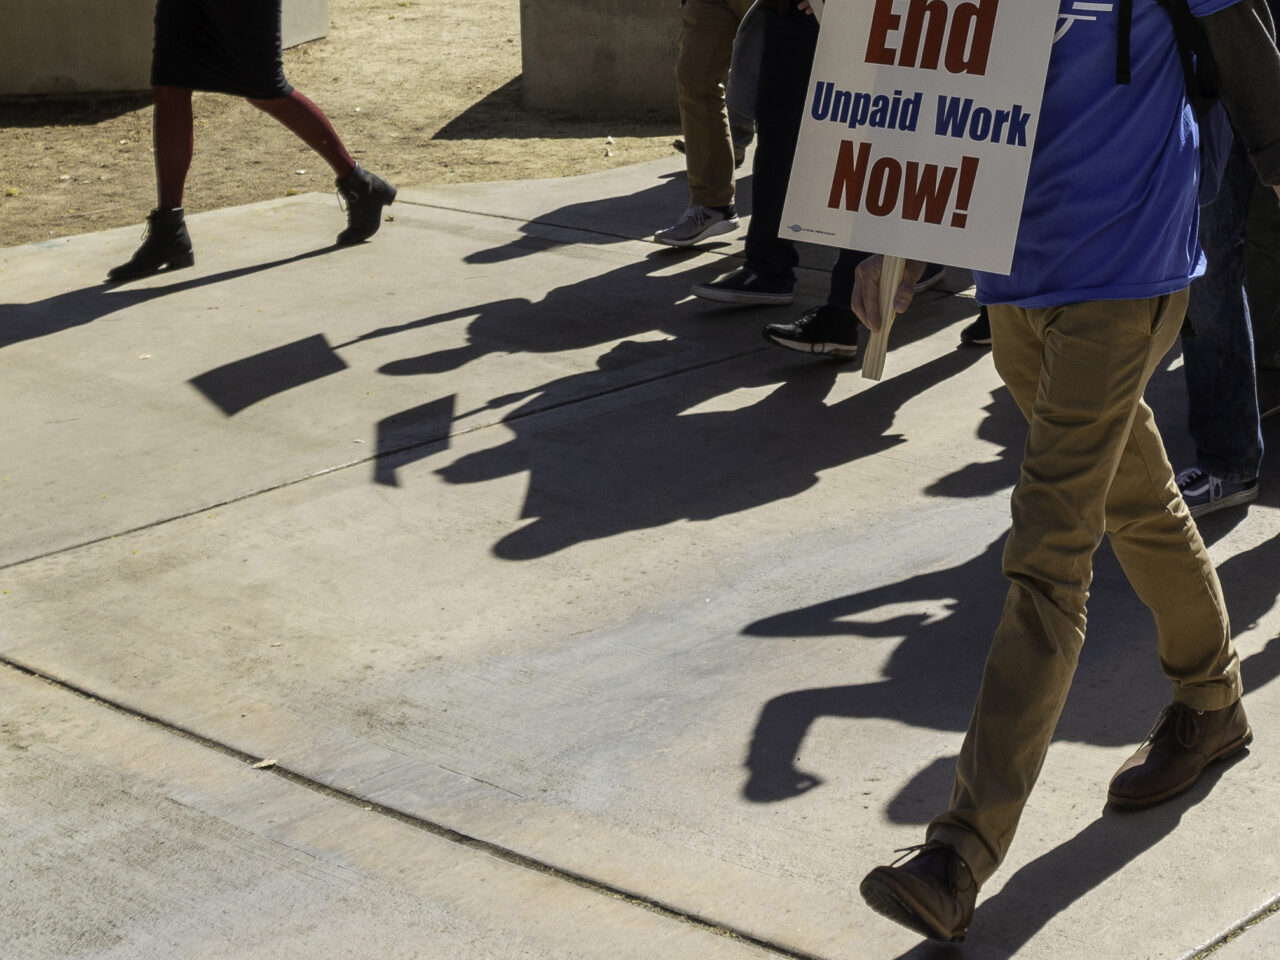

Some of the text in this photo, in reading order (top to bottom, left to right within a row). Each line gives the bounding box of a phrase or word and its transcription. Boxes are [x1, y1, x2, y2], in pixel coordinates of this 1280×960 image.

[810, 81, 1031, 147] Unpaid Work
[827, 139, 980, 229] Now!
